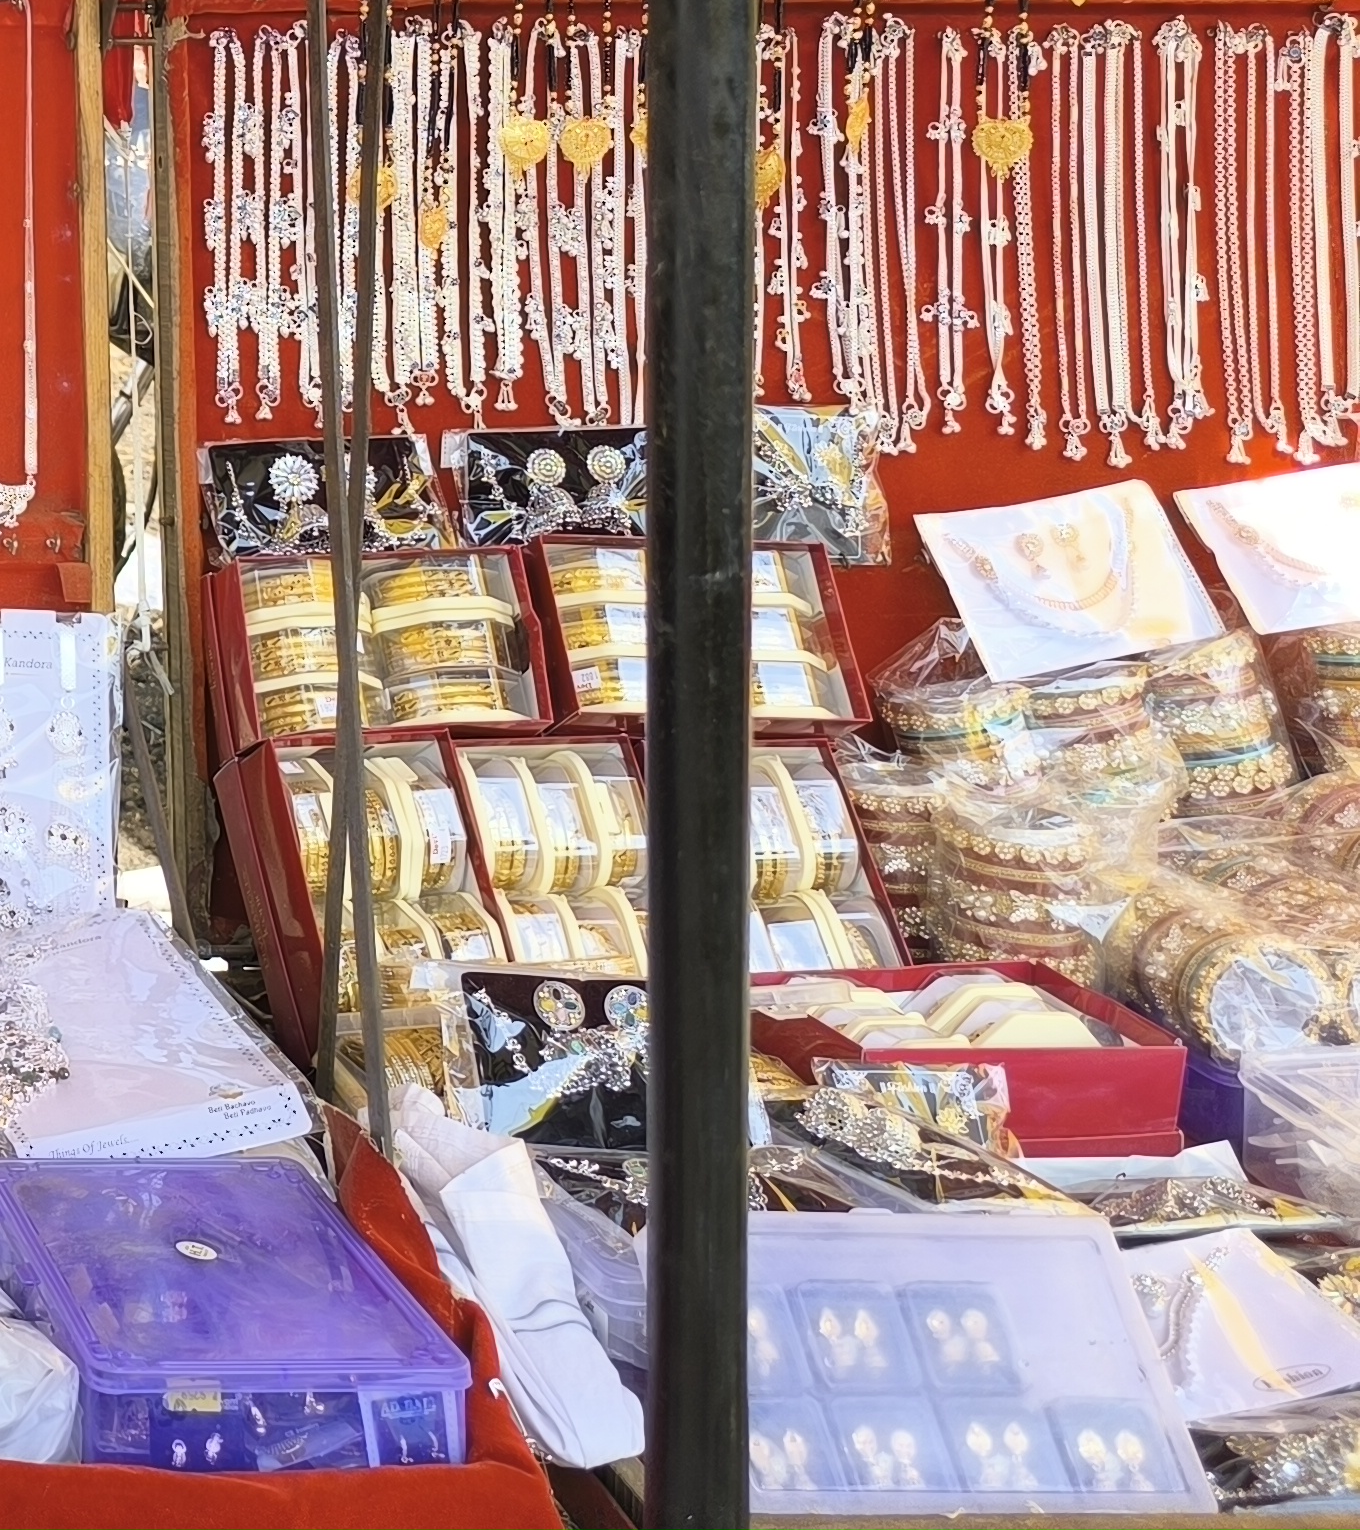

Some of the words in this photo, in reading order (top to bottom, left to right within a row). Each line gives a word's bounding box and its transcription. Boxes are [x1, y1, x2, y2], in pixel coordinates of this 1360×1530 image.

[3, 656, 53, 670] Kandora
[207, 1106, 223, 1114] Beti
[223, 1111, 239, 1120] Beti
[49, 1147, 80, 1159] Things
[82, 1140, 95, 1155] Of
